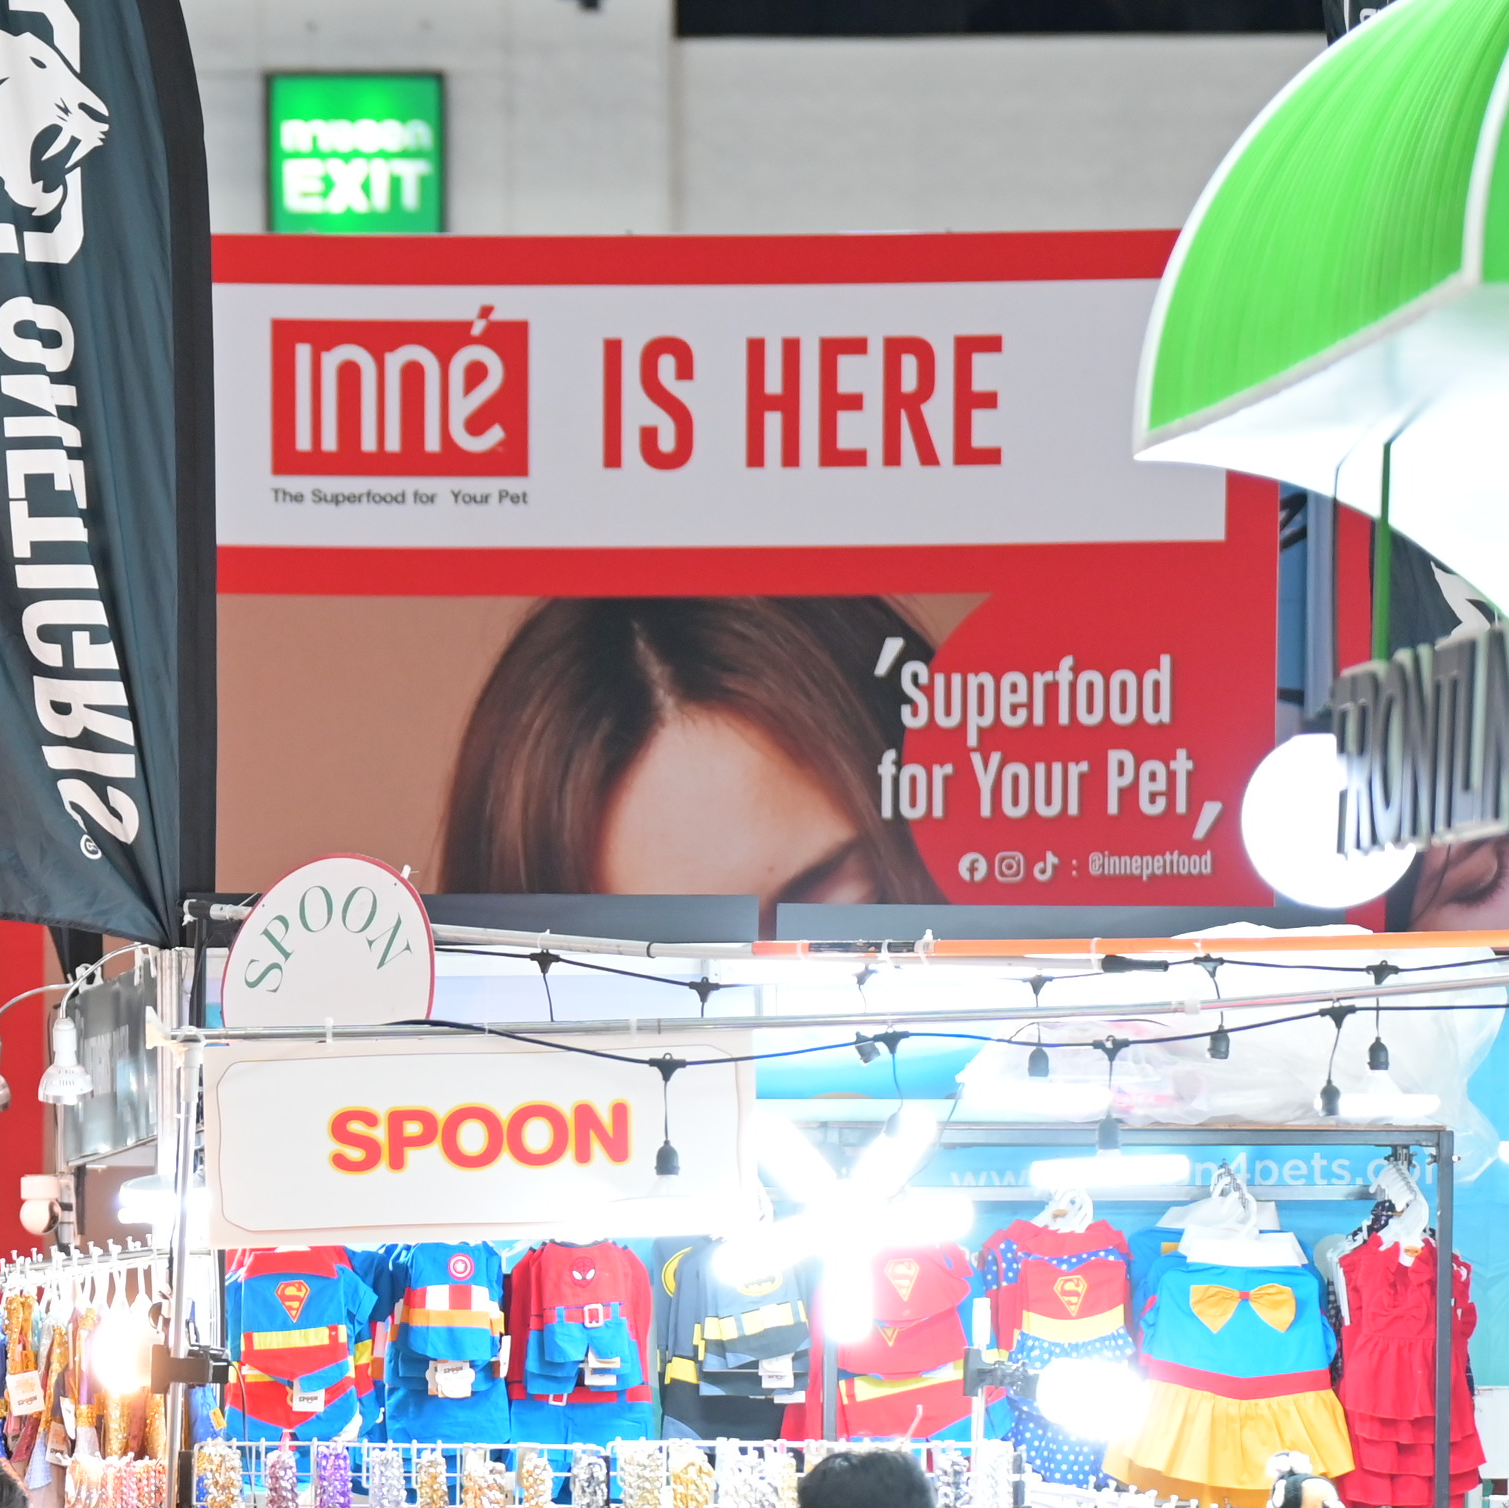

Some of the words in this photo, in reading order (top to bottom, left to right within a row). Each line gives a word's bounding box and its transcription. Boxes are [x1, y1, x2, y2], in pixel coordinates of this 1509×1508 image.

[282, 157, 433, 214] EXIT
[602, 335, 694, 470] IS
[745, 334, 1003, 469] HERE
[271, 487, 304, 503] The
[311, 488, 406, 506] Superfood
[413, 488, 437, 504] for
[450, 488, 492, 504] Your
[498, 489, 529, 504] Pet
[877, 749, 952, 820] for
[969, 751, 1089, 819] Your
[1088, 850, 1212, 881] @innepetfood
[244, 884, 413, 994] SPOON
[328, 1100, 634, 1174] SPOON
